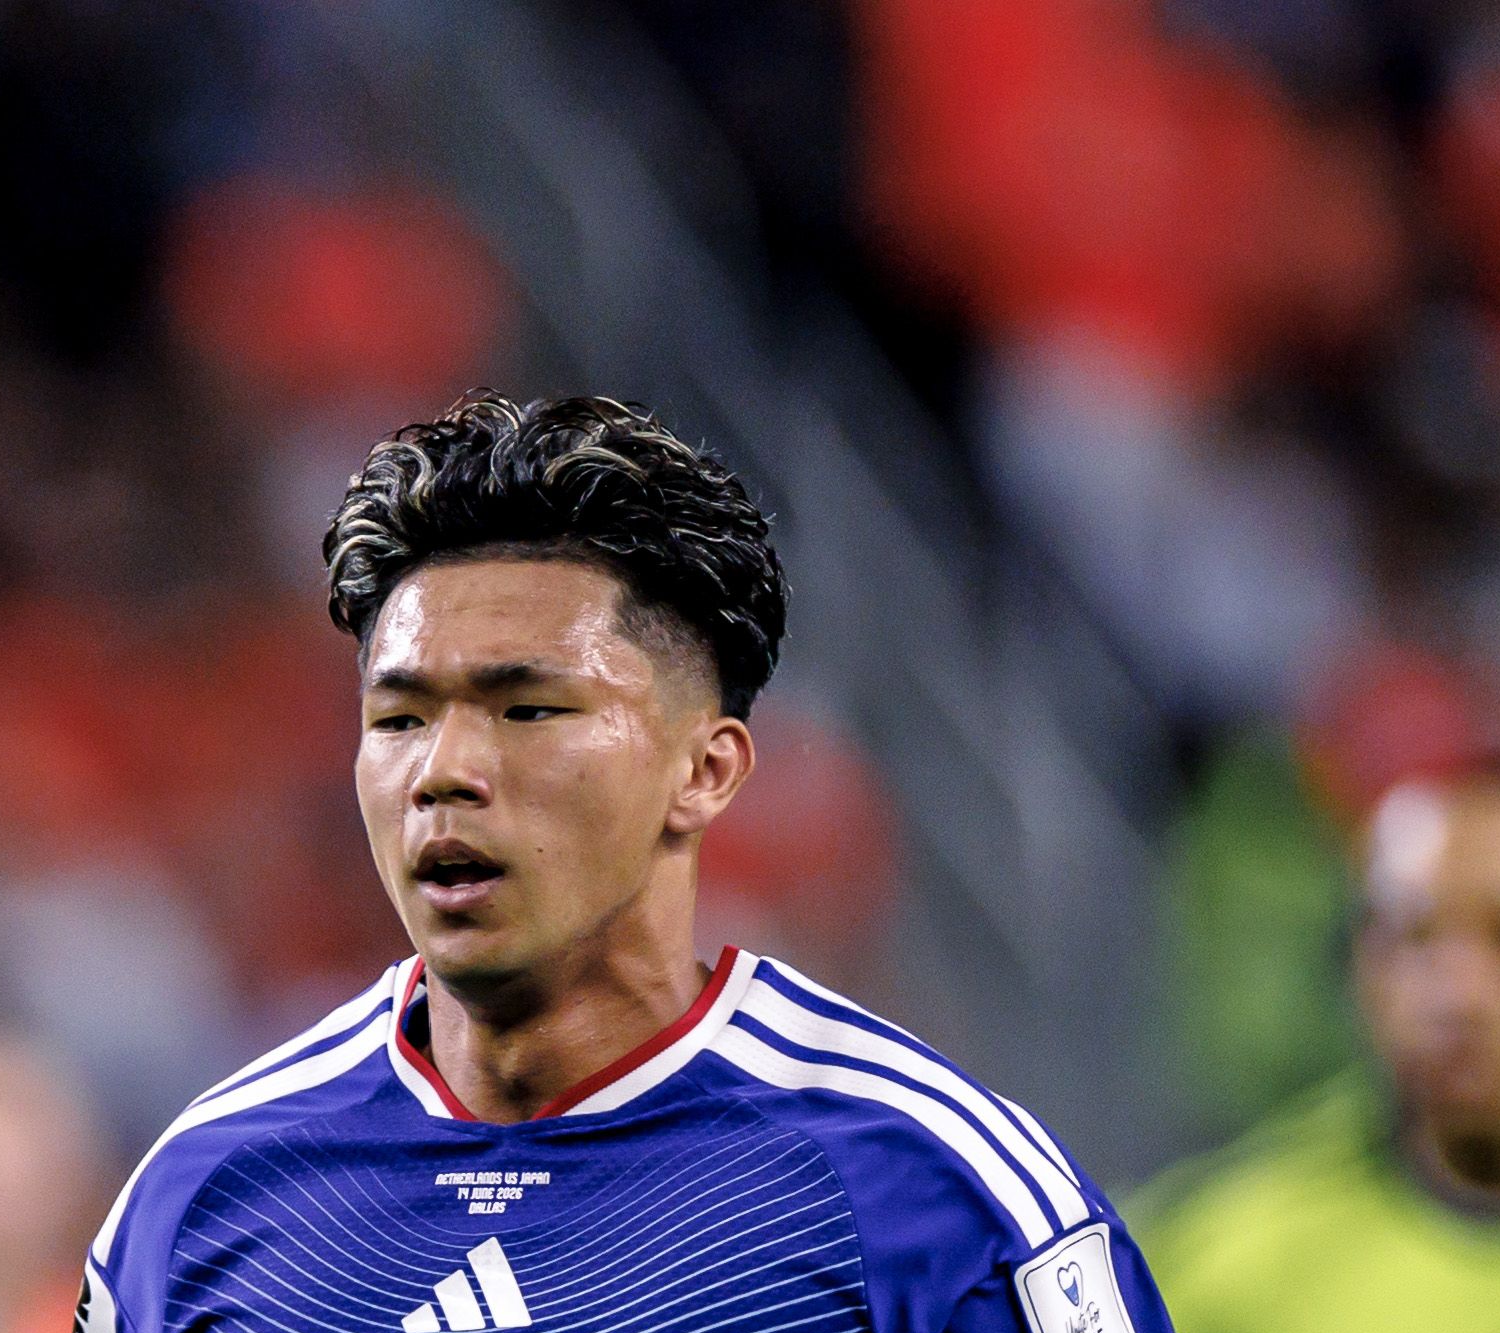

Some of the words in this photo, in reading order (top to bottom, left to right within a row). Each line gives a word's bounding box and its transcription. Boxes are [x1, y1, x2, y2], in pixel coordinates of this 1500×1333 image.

[435, 1172, 503, 1185] NETHERLANDS
[519, 1172, 550, 1185] JAPAN
[457, 1187, 469, 1200] 14
[470, 1187, 495, 1200] JUNE
[496, 1187, 524, 1200] 2026
[468, 1202, 506, 1214] DALLAS
